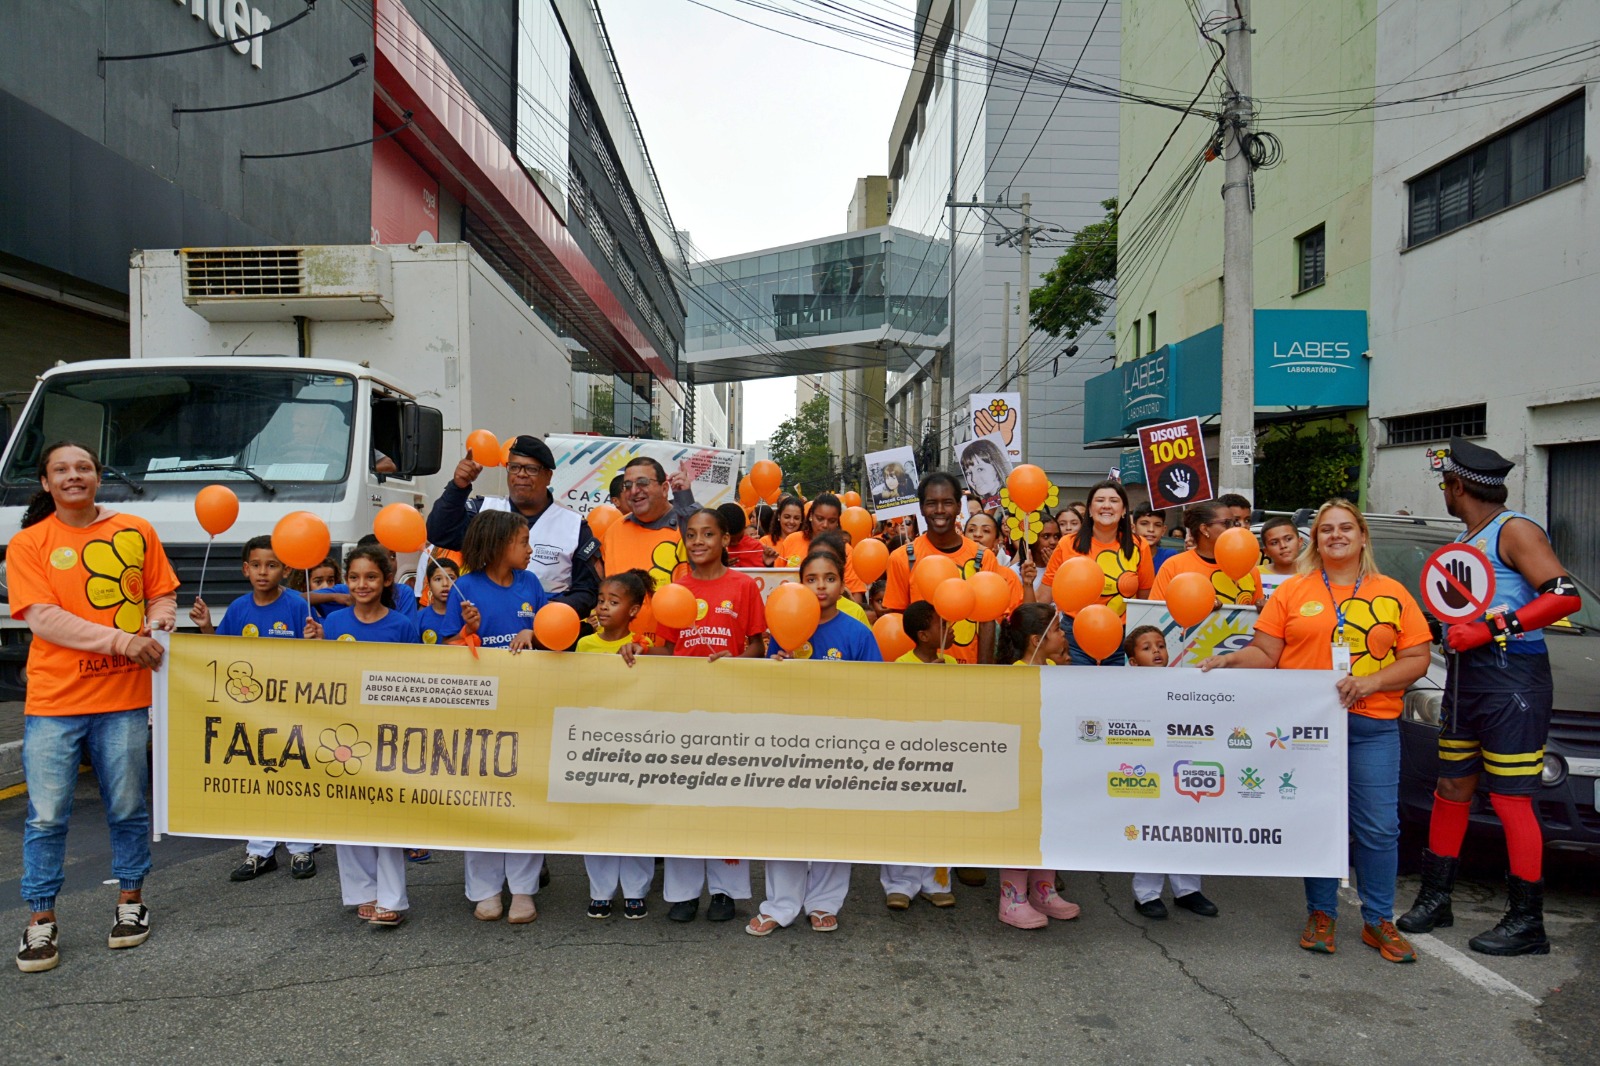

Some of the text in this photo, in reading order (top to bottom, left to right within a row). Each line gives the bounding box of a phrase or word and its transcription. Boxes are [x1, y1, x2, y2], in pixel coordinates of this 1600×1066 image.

[1273, 341, 1351, 358] LABES
[1124, 356, 1165, 394] LABES
[1150, 425, 1189, 442] DISQUE
[1149, 436, 1196, 464] 100!
[567, 489, 613, 504] CASA
[680, 626, 732, 638] PROGRAMA
[684, 637, 728, 648] CURUMIM
[206, 660, 348, 705] 18 DE MAIO
[386, 676, 426, 684] NACIONAL
[440, 678, 478, 686] COMBATE
[402, 684, 408, 692] À
[410, 686, 462, 697] EXPLORAÇÃO
[464, 688, 494, 697] SEXUAL
[1167, 692, 1235, 704] Realização:
[381, 695, 420, 704] CRIANÇAS
[429, 697, 490, 706] ADOLESCENTES
[1167, 724, 1214, 736] SMAS
[1292, 727, 1328, 739] PETI
[204, 716, 518, 777] FAÇA BONITO
[568, 725, 1008, 754] É necessário garantir a toda criança e adolescente
[1229, 739, 1251, 747] SUAS
[567, 747, 953, 772] o direito ao seu desenvolvimento, de forma
[565, 770, 967, 793] segura, protegida e livre da violência sexual.
[1110, 777, 1157, 788] CMDCA
[1182, 777, 1217, 788] 100
[204, 777, 515, 808] PROTEJA NOSSAS CRIANÇAS E ADOLESCENTES.
[1142, 825, 1282, 844] FACABONITO.ORG
